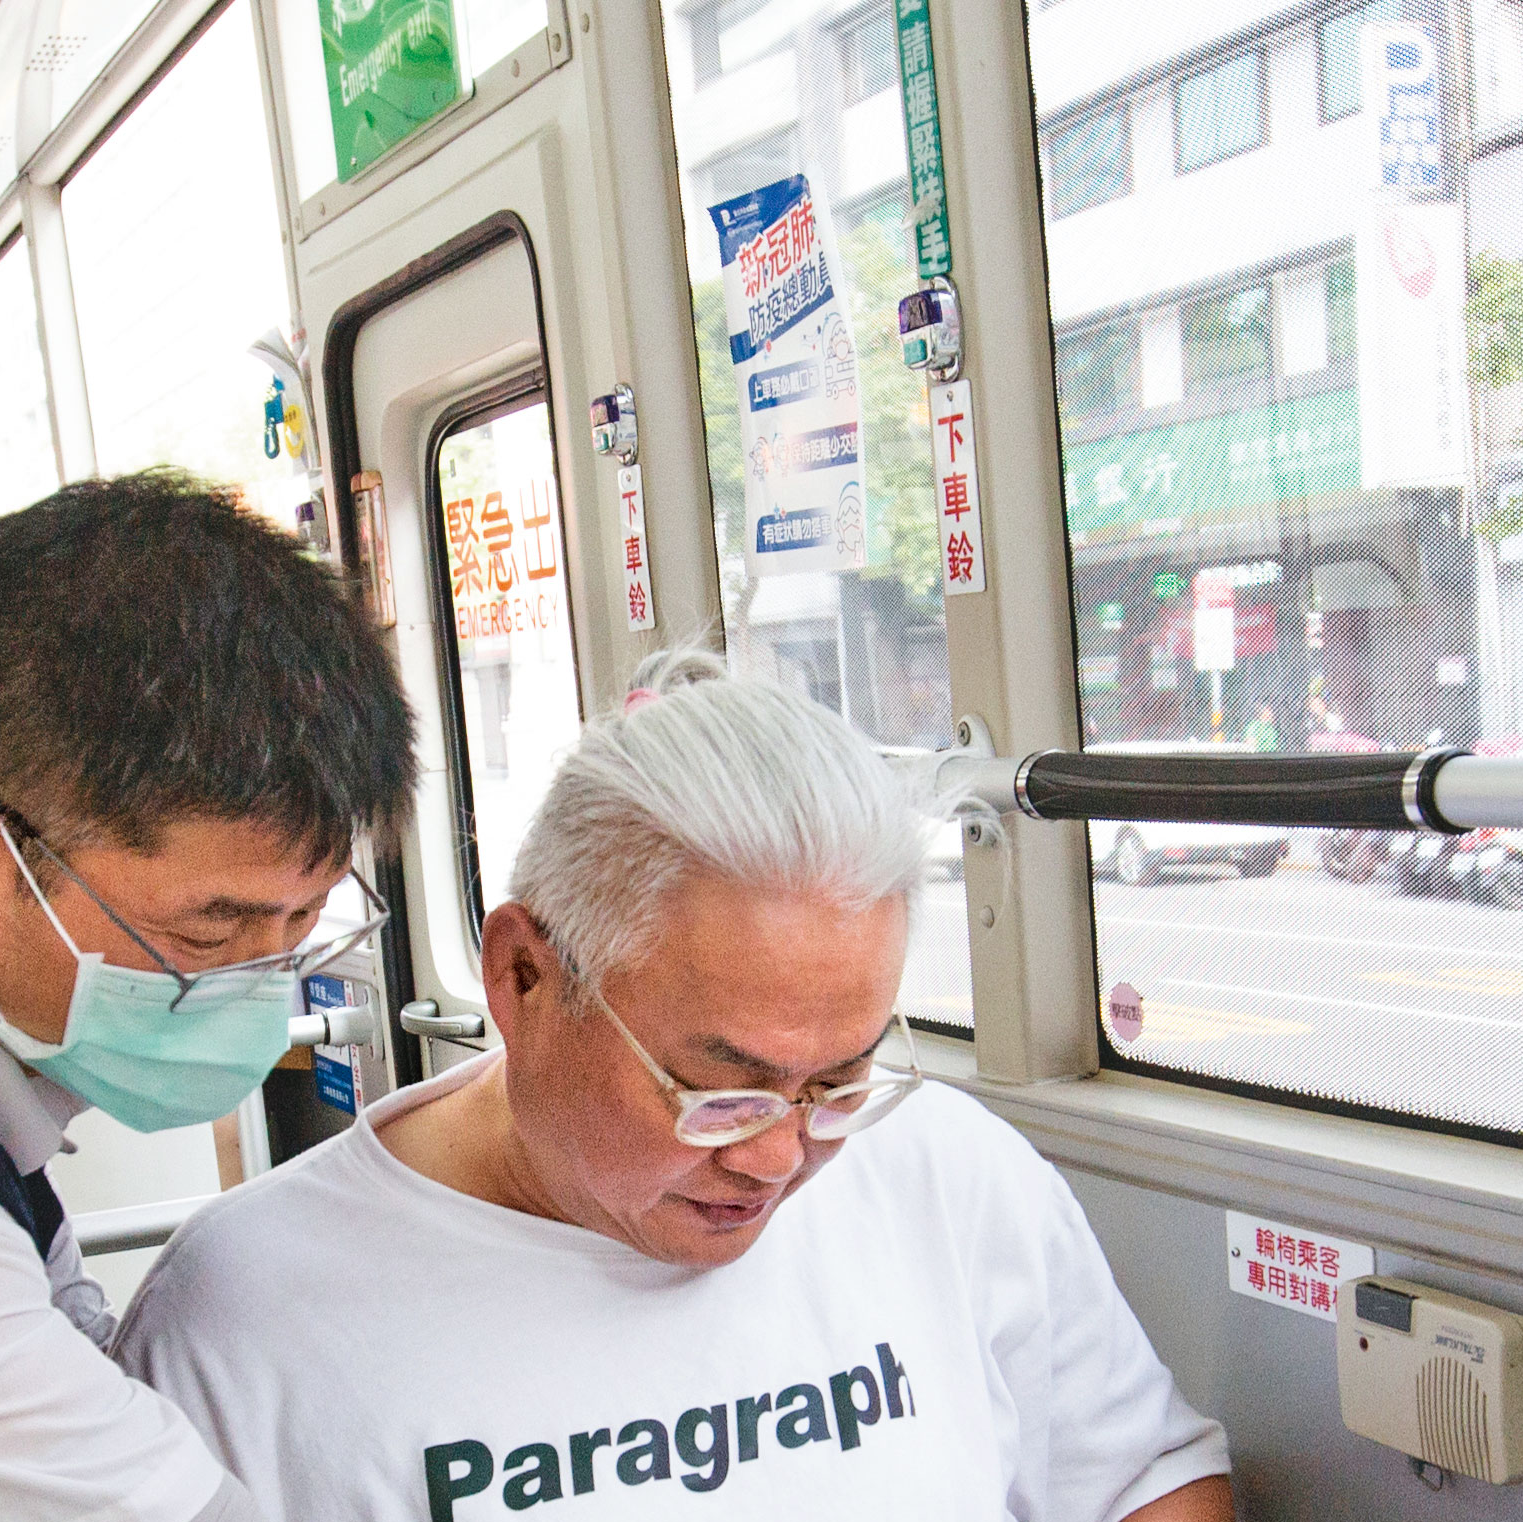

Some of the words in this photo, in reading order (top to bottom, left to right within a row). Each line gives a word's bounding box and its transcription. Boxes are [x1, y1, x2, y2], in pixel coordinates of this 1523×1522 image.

[339, 28, 404, 106] Emergency
[407, 5, 432, 50] exit
[739, 200, 819, 298] 新冠肺
[938, 412, 974, 582] 下車鈴
[622, 490, 646, 621] 下車鈴
[458, 594, 559, 640] EMERGENCY
[1246, 1260, 1339, 1313] 專用對講
[1255, 1227, 1340, 1279] 輪椅乘客
